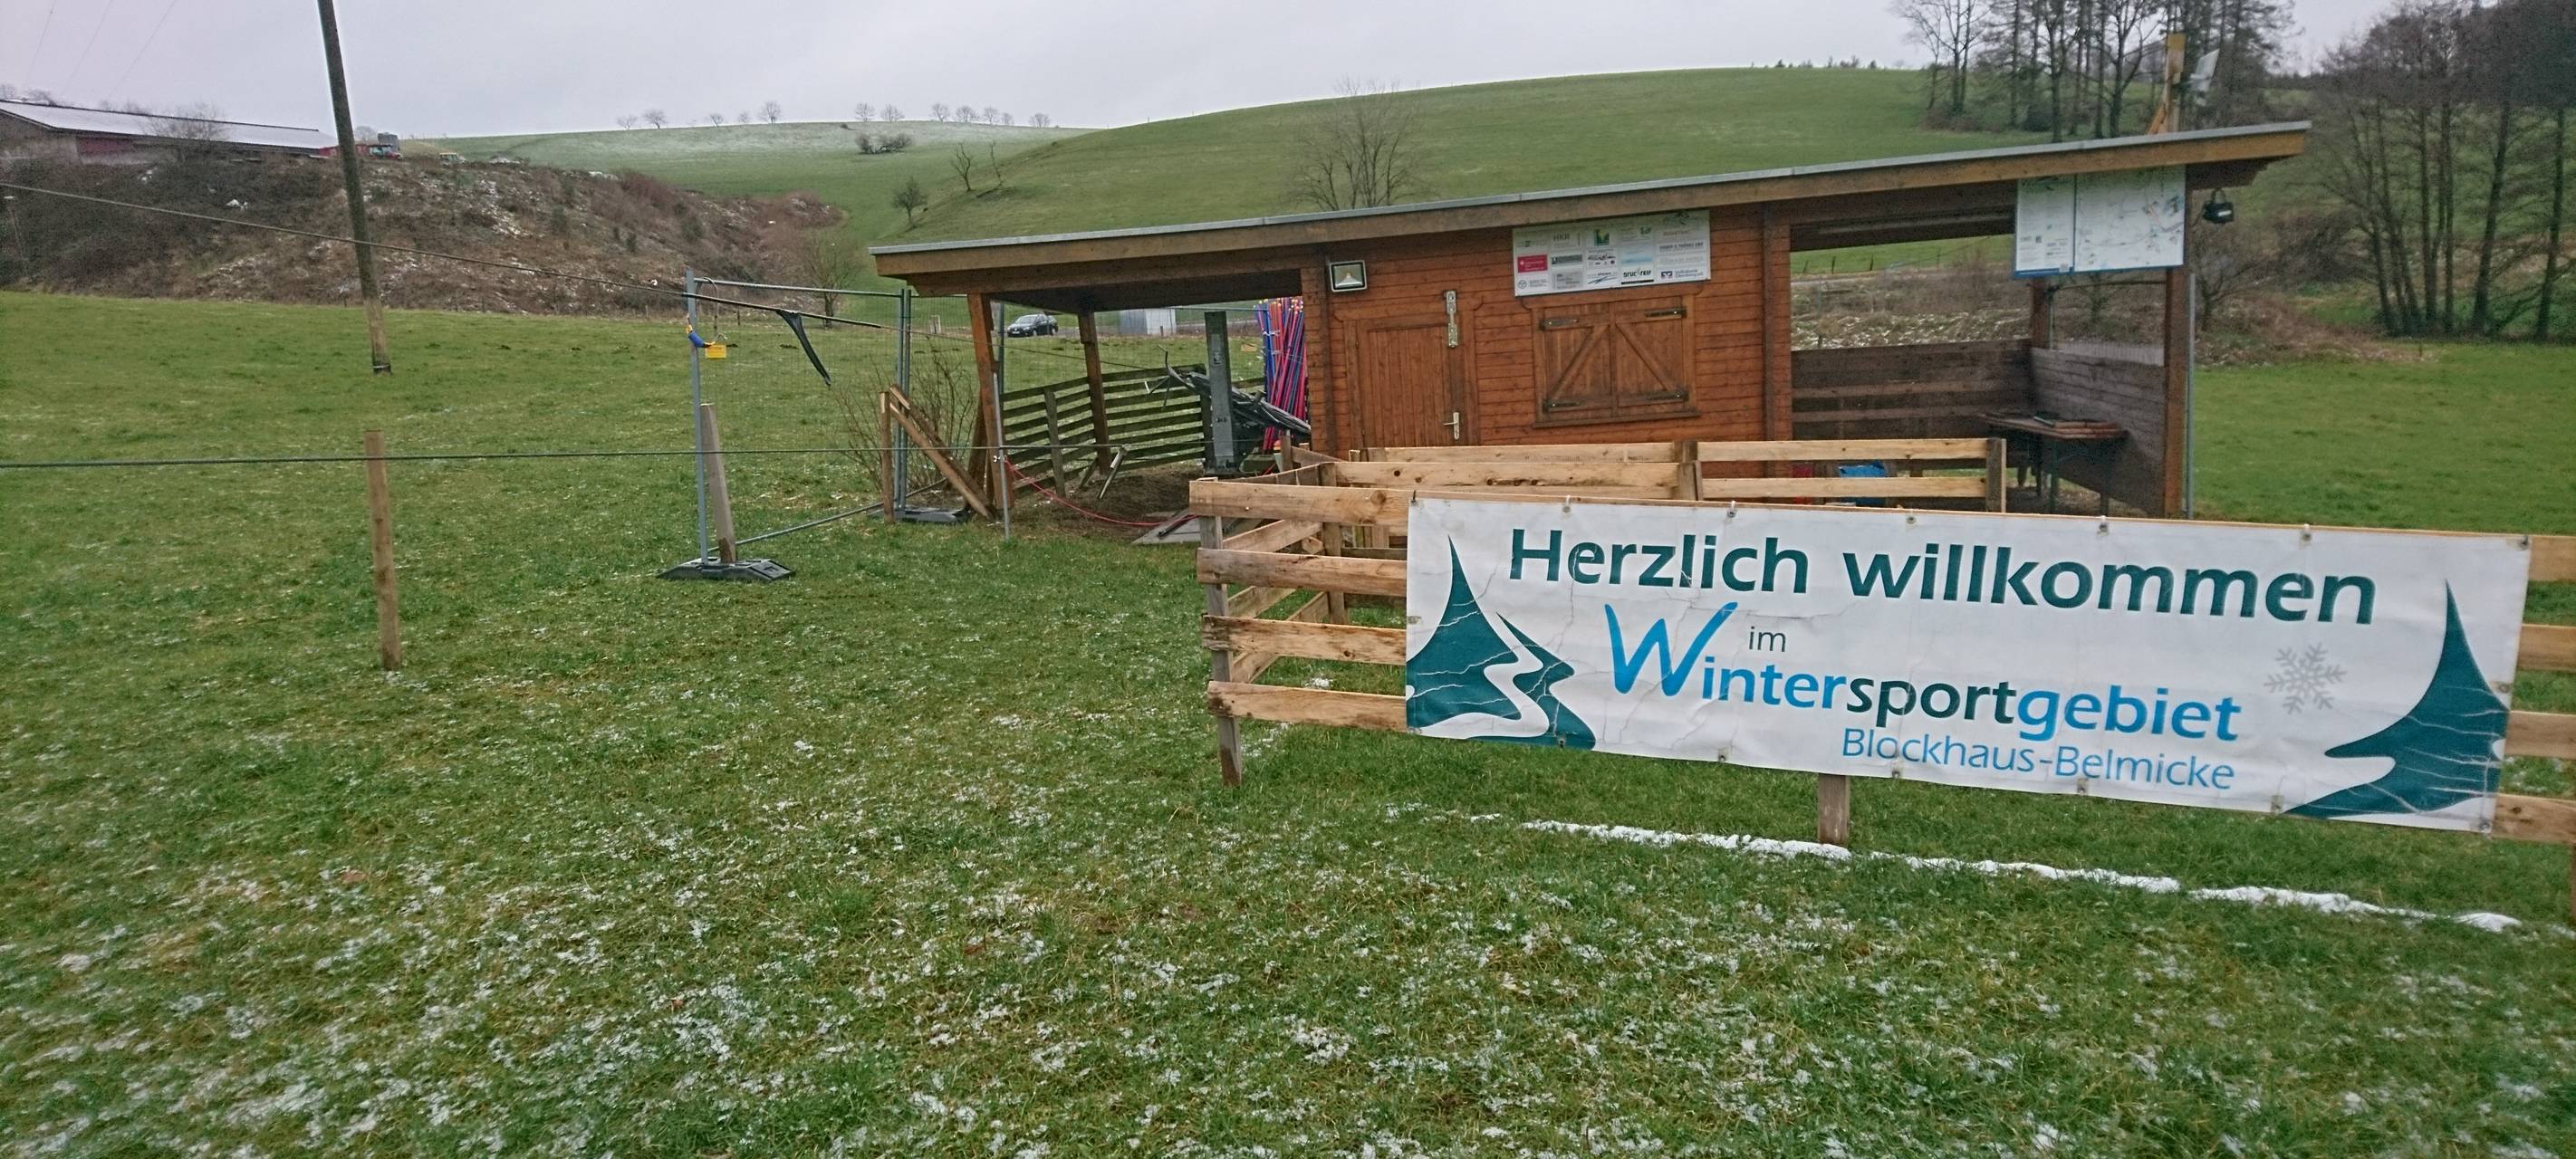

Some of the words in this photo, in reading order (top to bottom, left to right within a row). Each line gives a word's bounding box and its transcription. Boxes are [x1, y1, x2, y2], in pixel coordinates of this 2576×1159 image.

[1508, 528, 1809, 594] Herzlich
[1842, 542, 2377, 625] willkommen
[1603, 601, 2243, 742] Wintersportgebiet
[1748, 625, 1786, 653] im
[1841, 727, 2235, 790] Blockhaus-Belmicke
